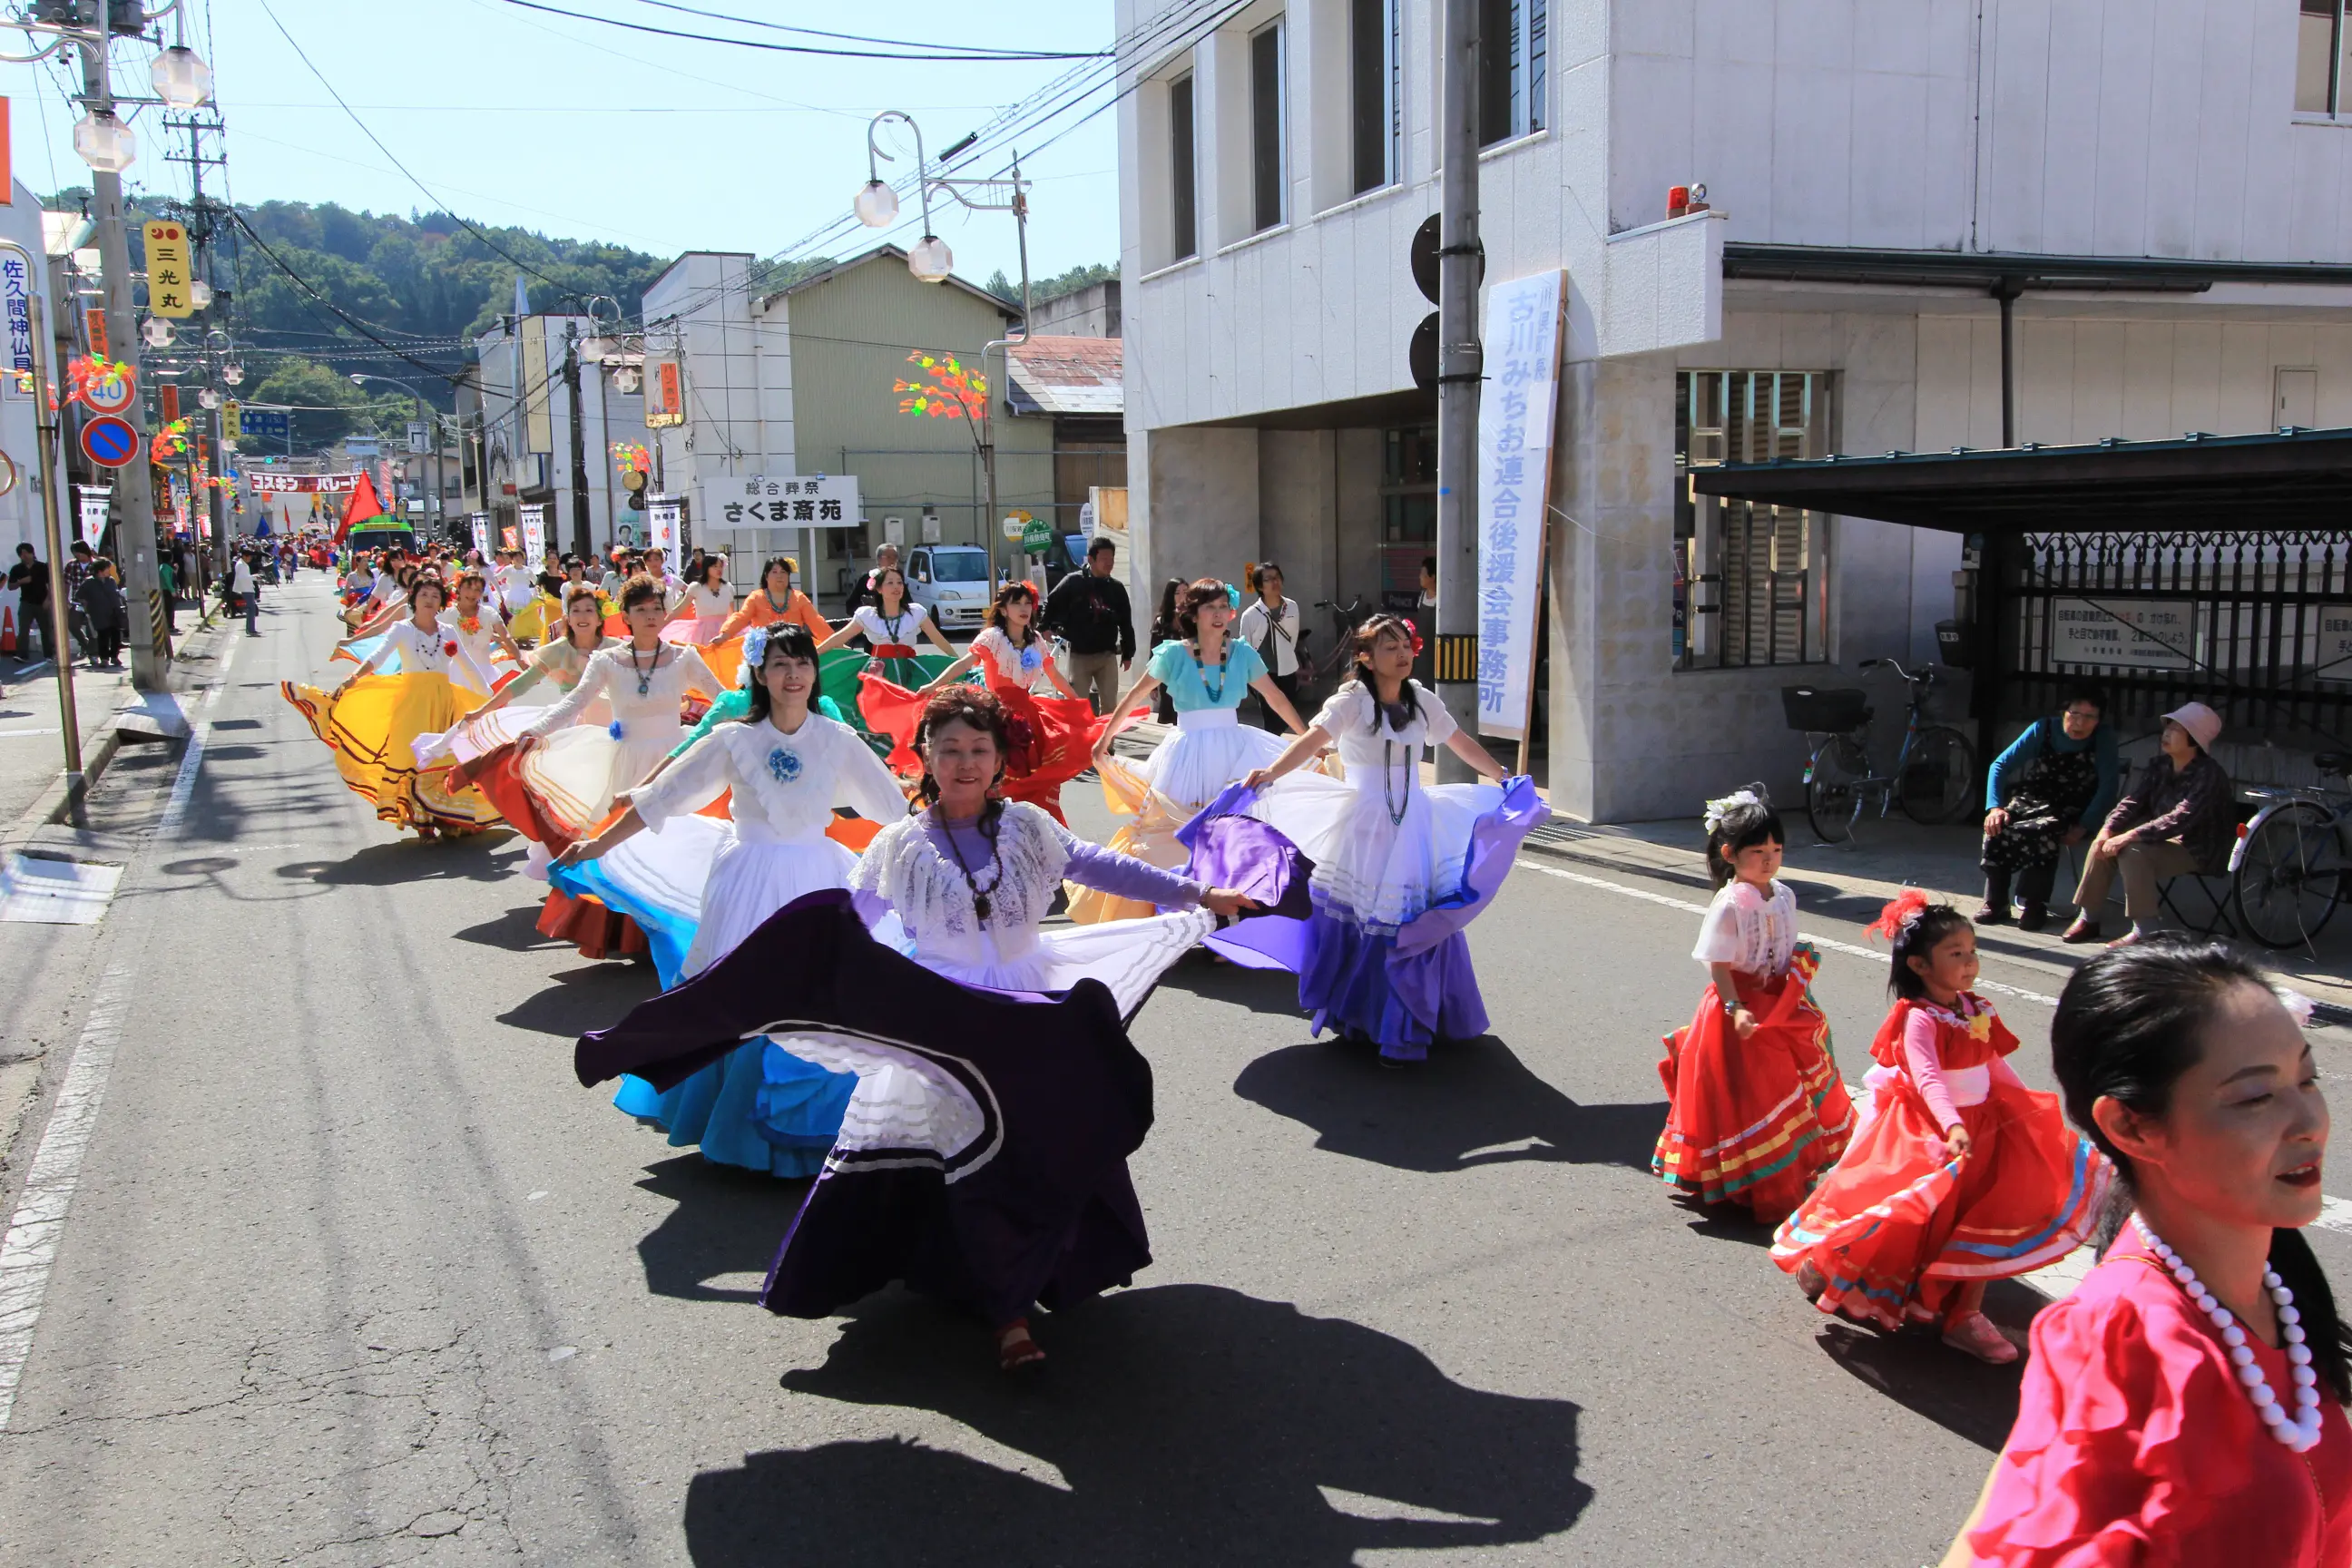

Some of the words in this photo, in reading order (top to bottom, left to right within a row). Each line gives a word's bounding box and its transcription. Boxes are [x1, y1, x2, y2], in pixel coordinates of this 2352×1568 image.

[157, 249, 183, 309] 三光丸
[92, 377, 123, 399] 40
[252, 475, 299, 491] コスキン
[316, 475, 360, 491] パレード
[746, 481, 819, 495] 総合葬祭
[723, 499, 842, 523] さくま斎苑
